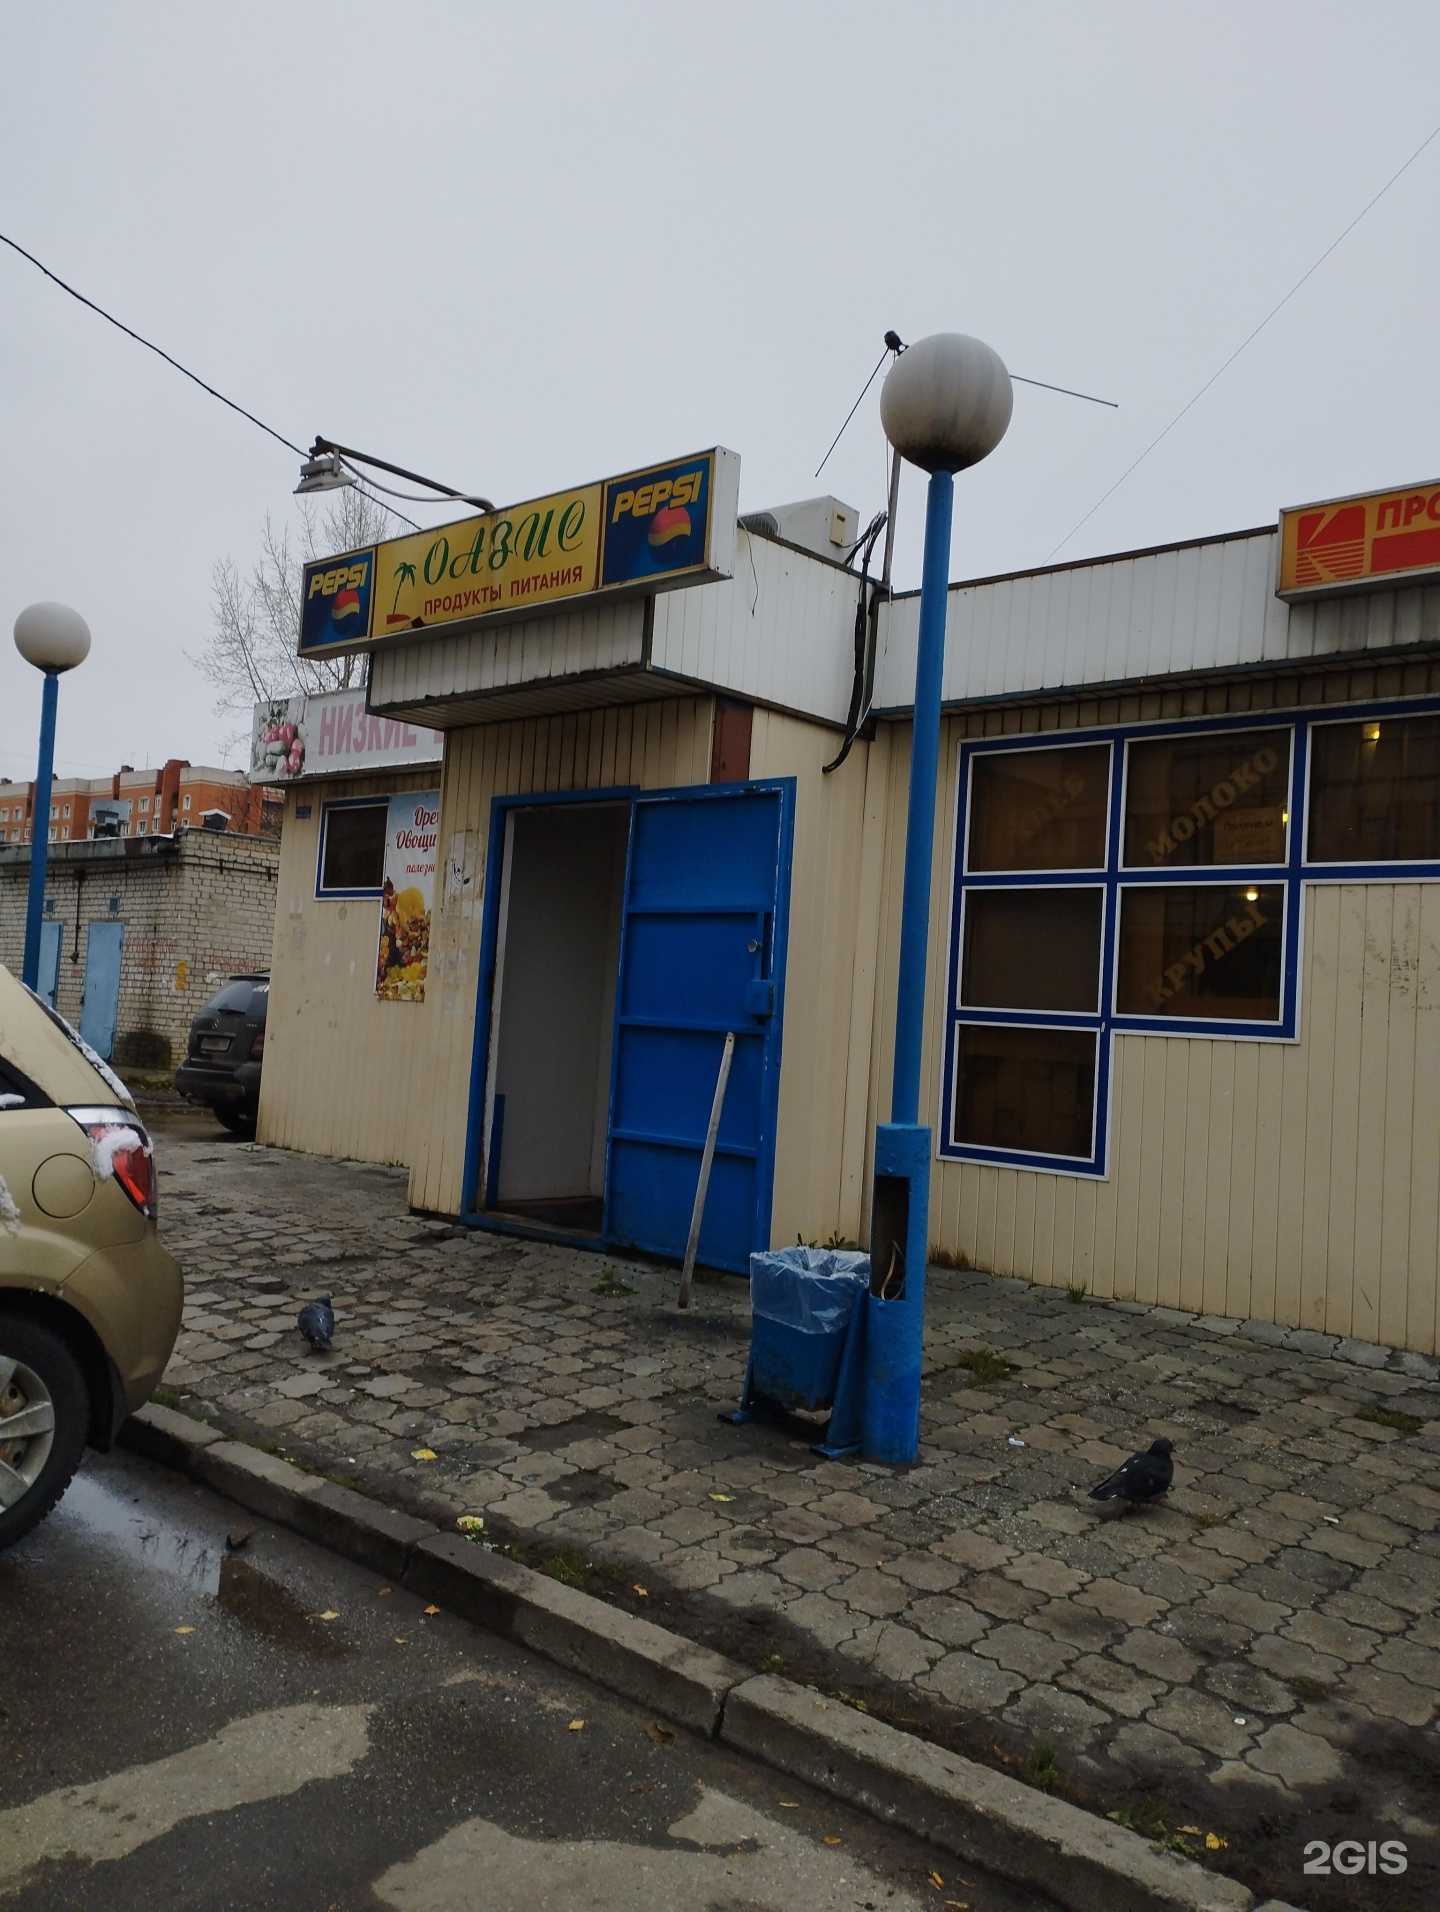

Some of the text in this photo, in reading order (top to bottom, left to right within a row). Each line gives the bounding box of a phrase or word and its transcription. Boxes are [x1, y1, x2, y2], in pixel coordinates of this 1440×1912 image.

[612, 471, 703, 523] PEPSI
[424, 500, 586, 585] ОАЗИС
[308, 561, 367, 599] PEPSI
[424, 565, 583, 617] ПРОДУКТЫ ПИТАНИЯ
[319, 704, 416, 755] НИЗКИЕ
[1149, 748, 1278, 862] МОЛОКО
